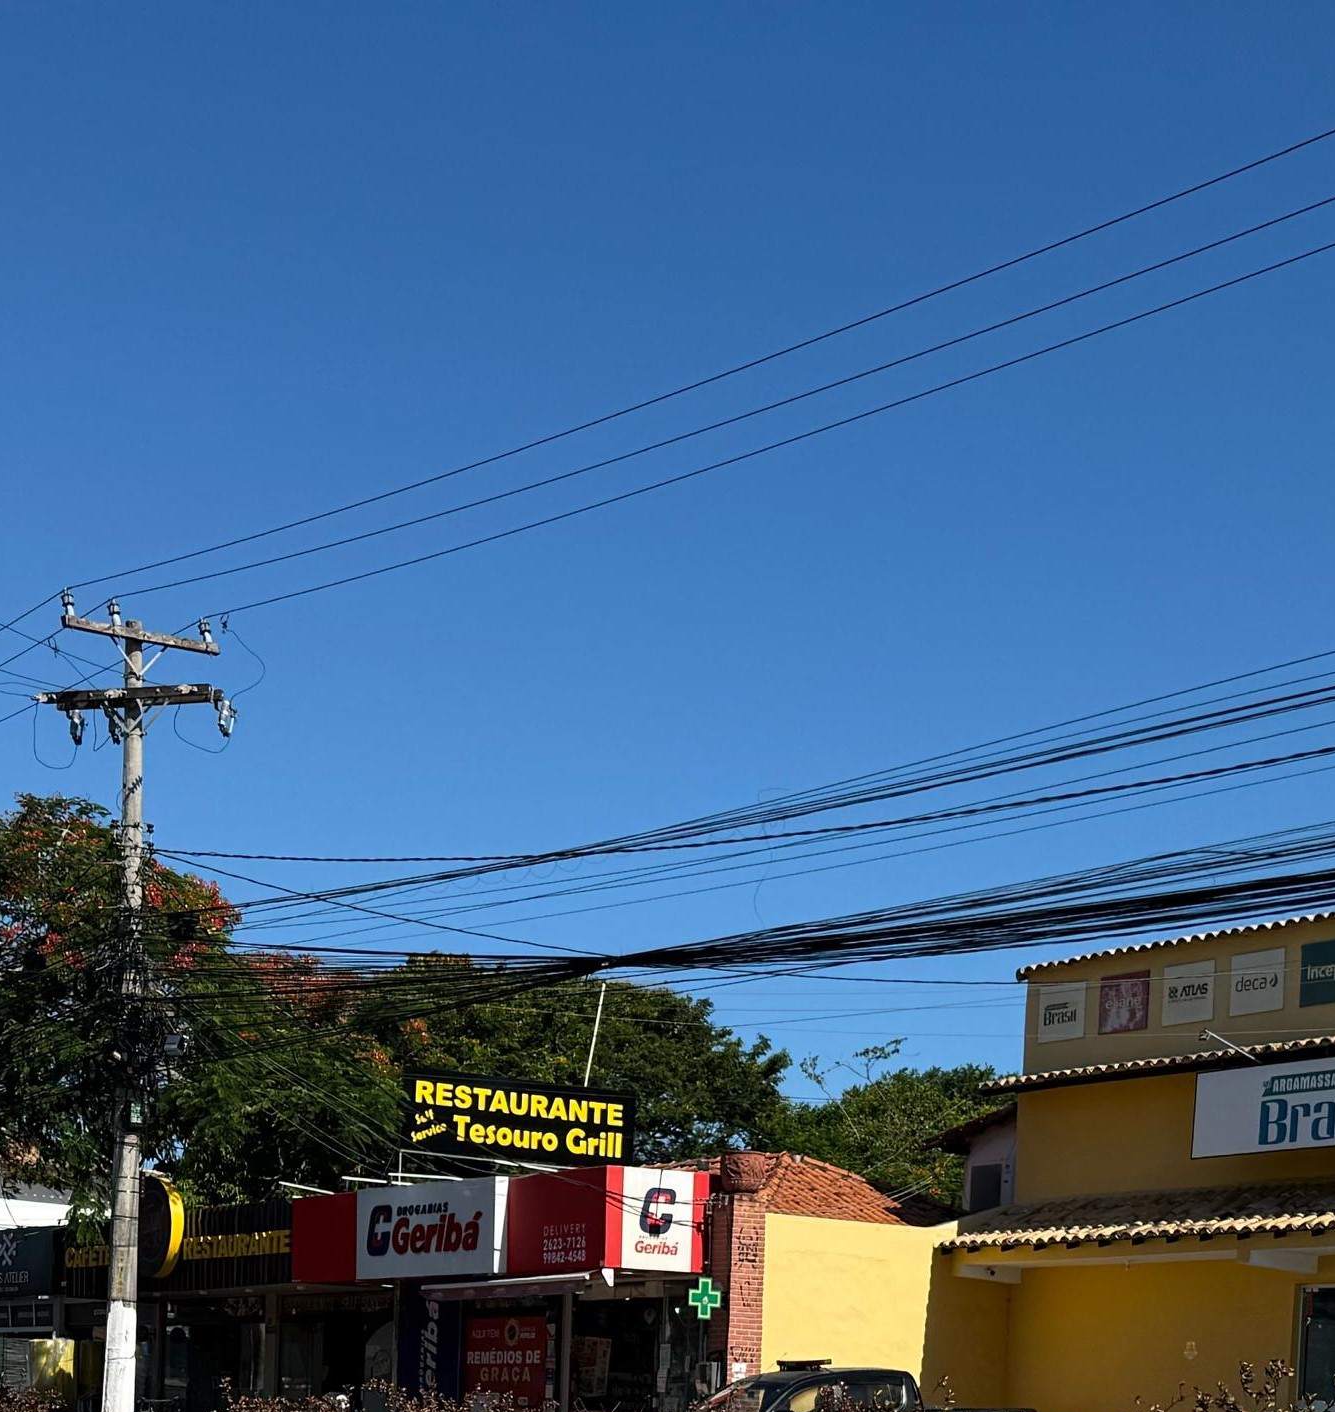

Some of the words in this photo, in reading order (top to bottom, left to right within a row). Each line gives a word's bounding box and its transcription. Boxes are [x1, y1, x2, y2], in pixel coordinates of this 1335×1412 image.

[1180, 983, 1209, 998] ATLAS
[1235, 975, 1267, 993] deca
[1044, 1009, 1077, 1027] Brasil
[415, 1080, 624, 1127] RESTAURANTE
[410, 1122, 447, 1143] Service
[453, 1114, 559, 1152] Tesouro
[565, 1127, 623, 1159] Grill
[396, 1201, 449, 1217] DROGARIAS
[391, 1210, 483, 1256] Geribá
[543, 1223, 586, 1237] DELIVERY
[183, 1229, 291, 1260] RESTAURANTE
[543, 1236, 587, 1251] 2623-7126
[634, 1240, 679, 1256] Geribá
[467, 1347, 523, 1365] REMÉDIOS
[525, 1349, 542, 1364] DE
[480, 1366, 532, 1385] GRAÇA
